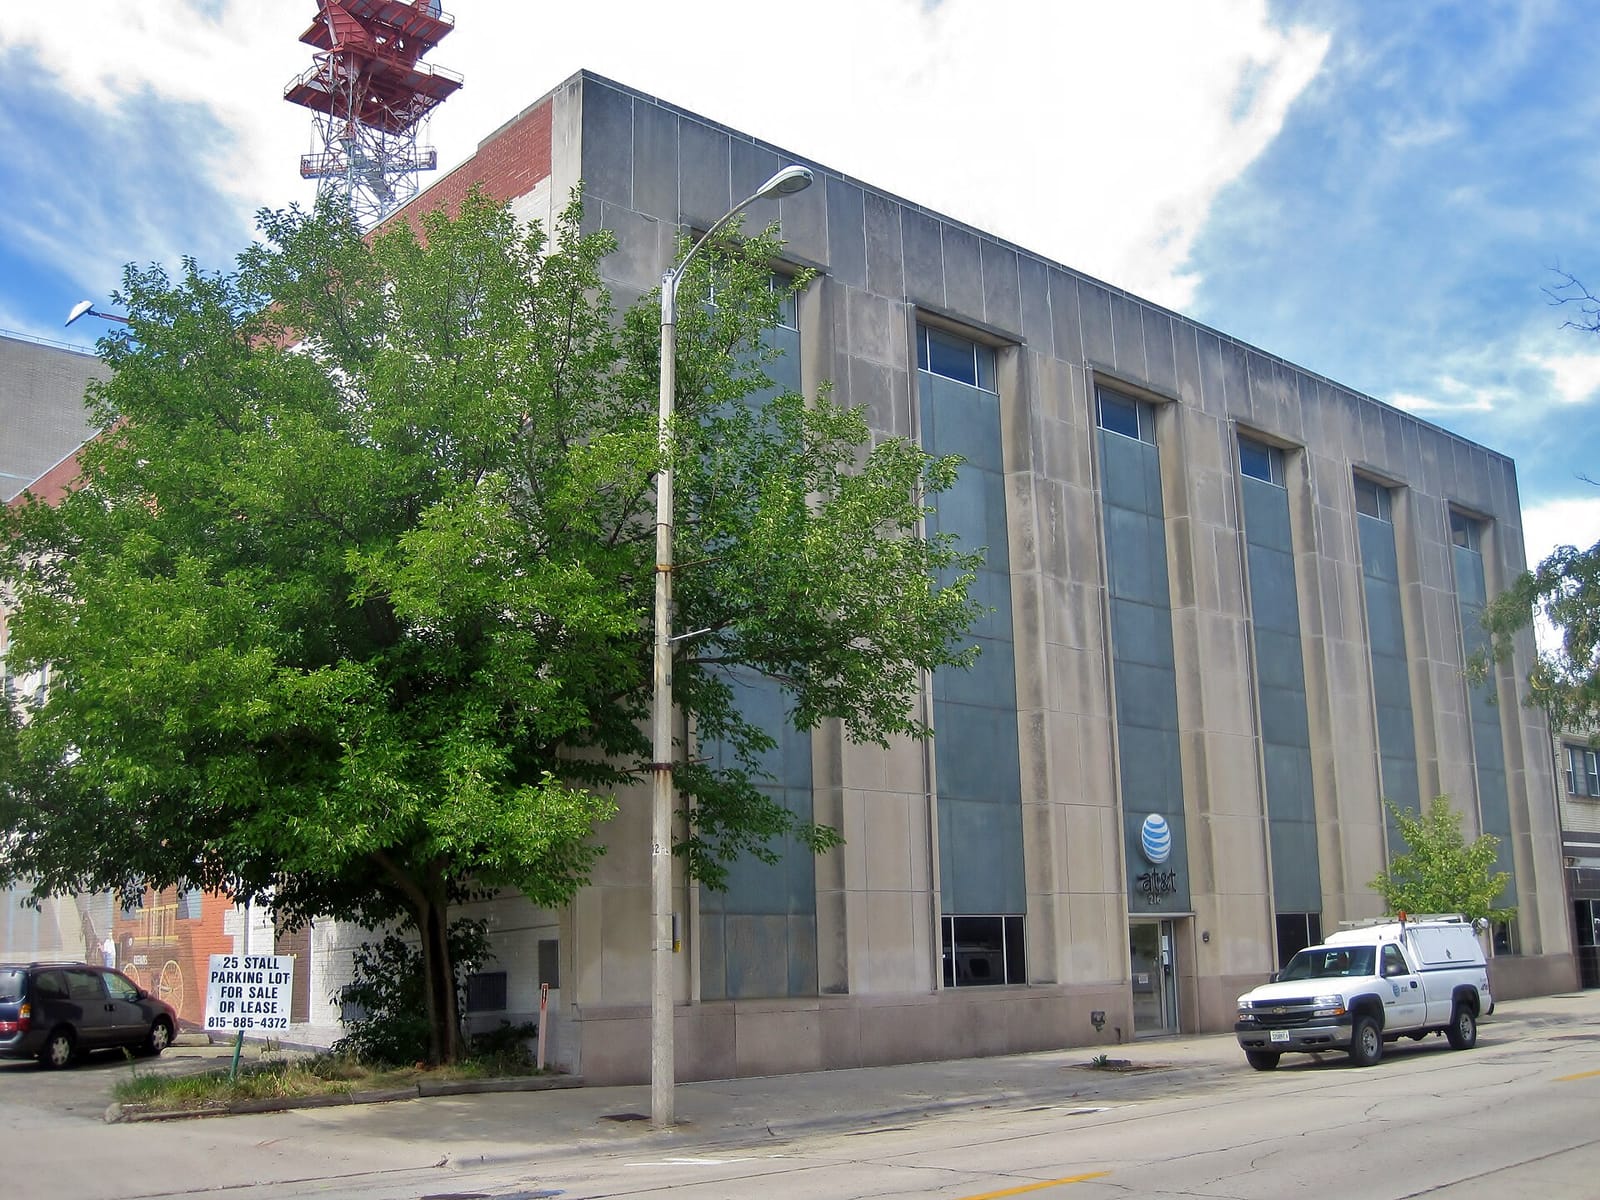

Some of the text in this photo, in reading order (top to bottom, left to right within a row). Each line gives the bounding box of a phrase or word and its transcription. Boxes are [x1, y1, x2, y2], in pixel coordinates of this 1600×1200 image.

[1143, 867, 1177, 893] at&t
[223, 956, 279, 969] 25 STALL
[211, 971, 290, 984] PARKING LOT
[221, 986, 278, 999] FOR SALE
[219, 1001, 278, 1014] OR LEASE
[208, 1016, 287, 1029] 815-885-4372
